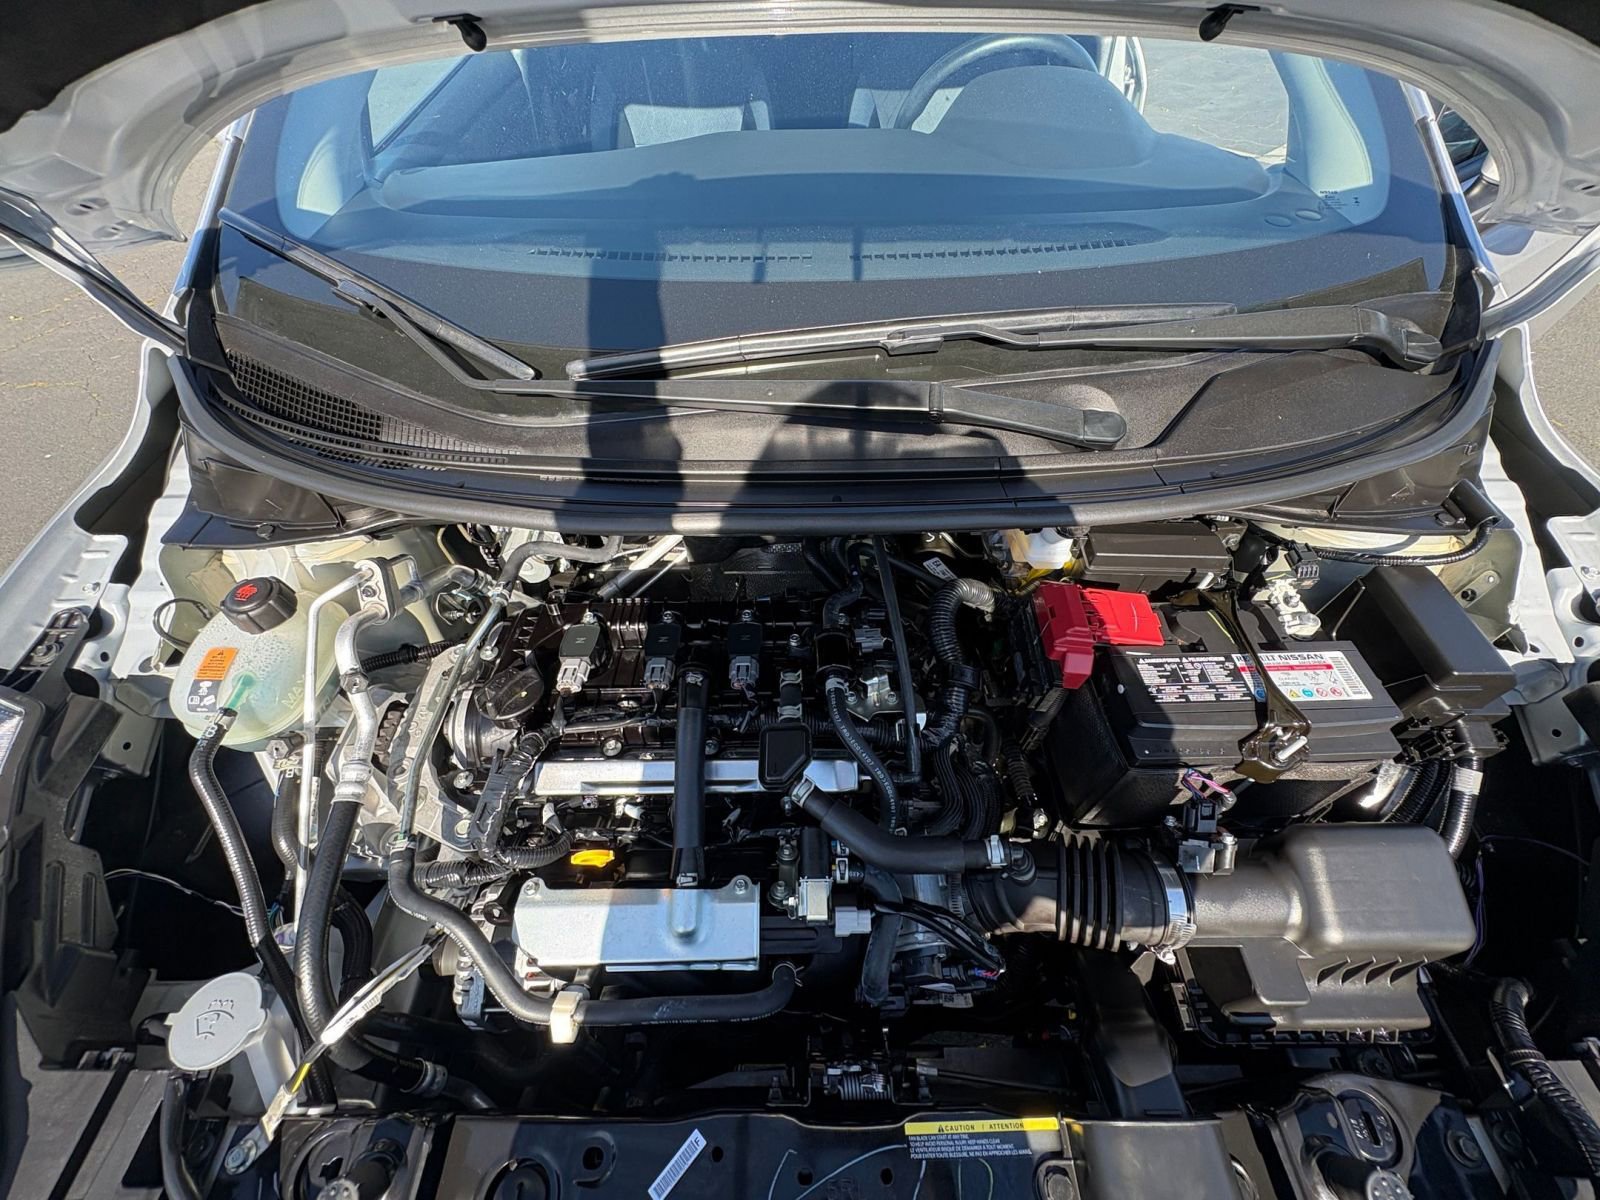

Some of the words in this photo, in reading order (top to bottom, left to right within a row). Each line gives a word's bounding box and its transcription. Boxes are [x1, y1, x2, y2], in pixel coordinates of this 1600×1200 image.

[1278, 653, 1324, 661] NISSAN
[944, 1124, 975, 1132] CAUTION
[989, 1122, 1024, 1130] ATTENTION
